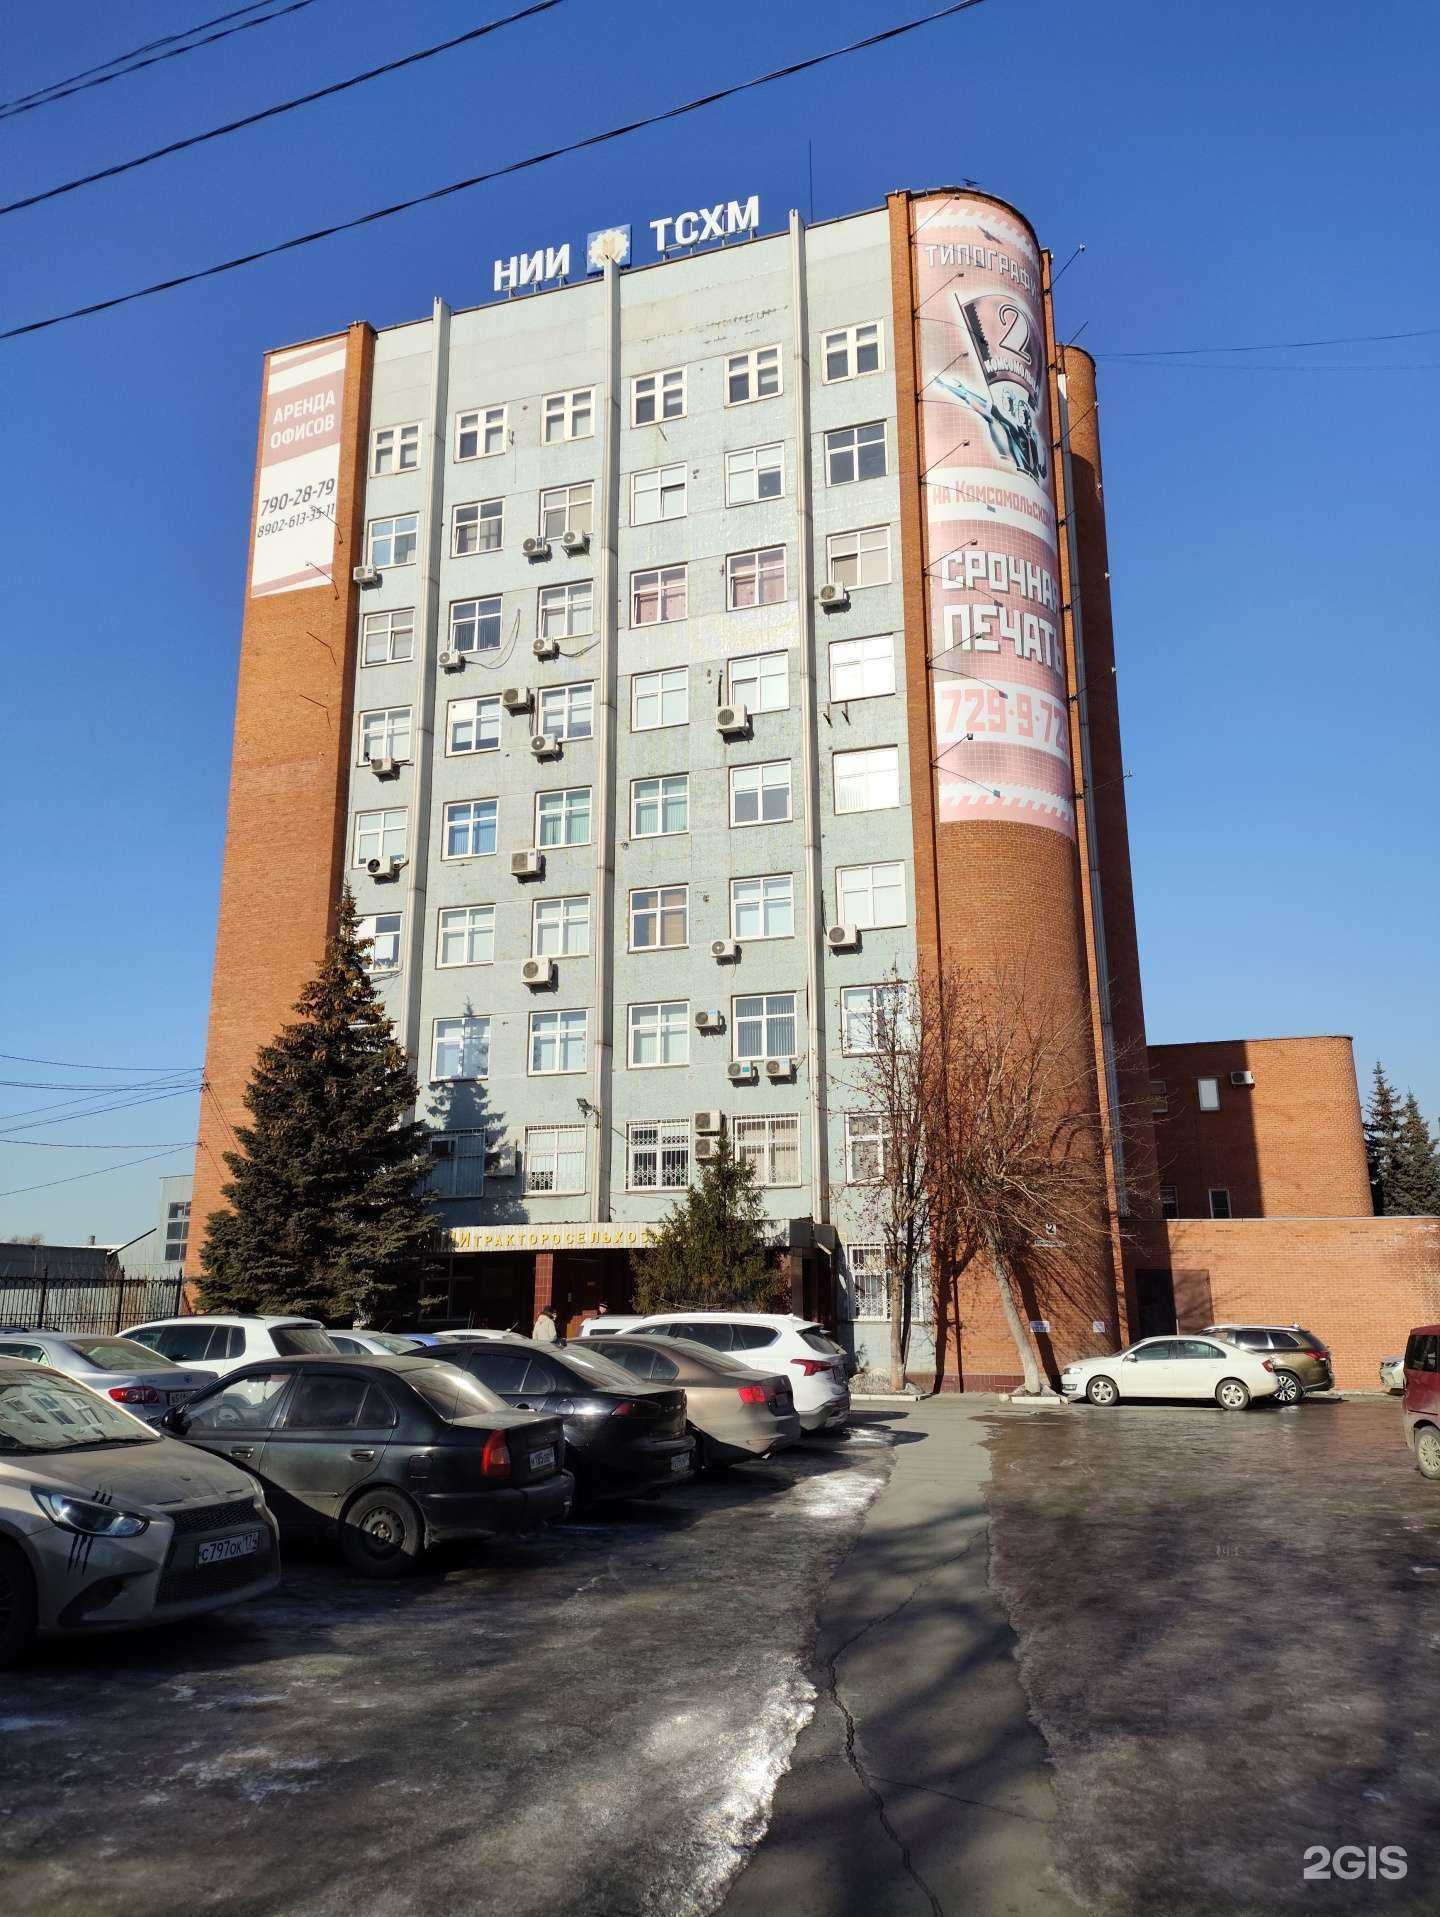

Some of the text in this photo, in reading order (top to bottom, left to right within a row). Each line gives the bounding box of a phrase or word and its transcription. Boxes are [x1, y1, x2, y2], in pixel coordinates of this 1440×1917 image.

[494, 195, 759, 291] НИИ ТСХМ
[998, 304, 1032, 365] 2
[272, 389, 336, 425] АРЕНДА
[269, 414, 335, 449] ОФИСОВ
[260, 478, 336, 517] 790-28-79
